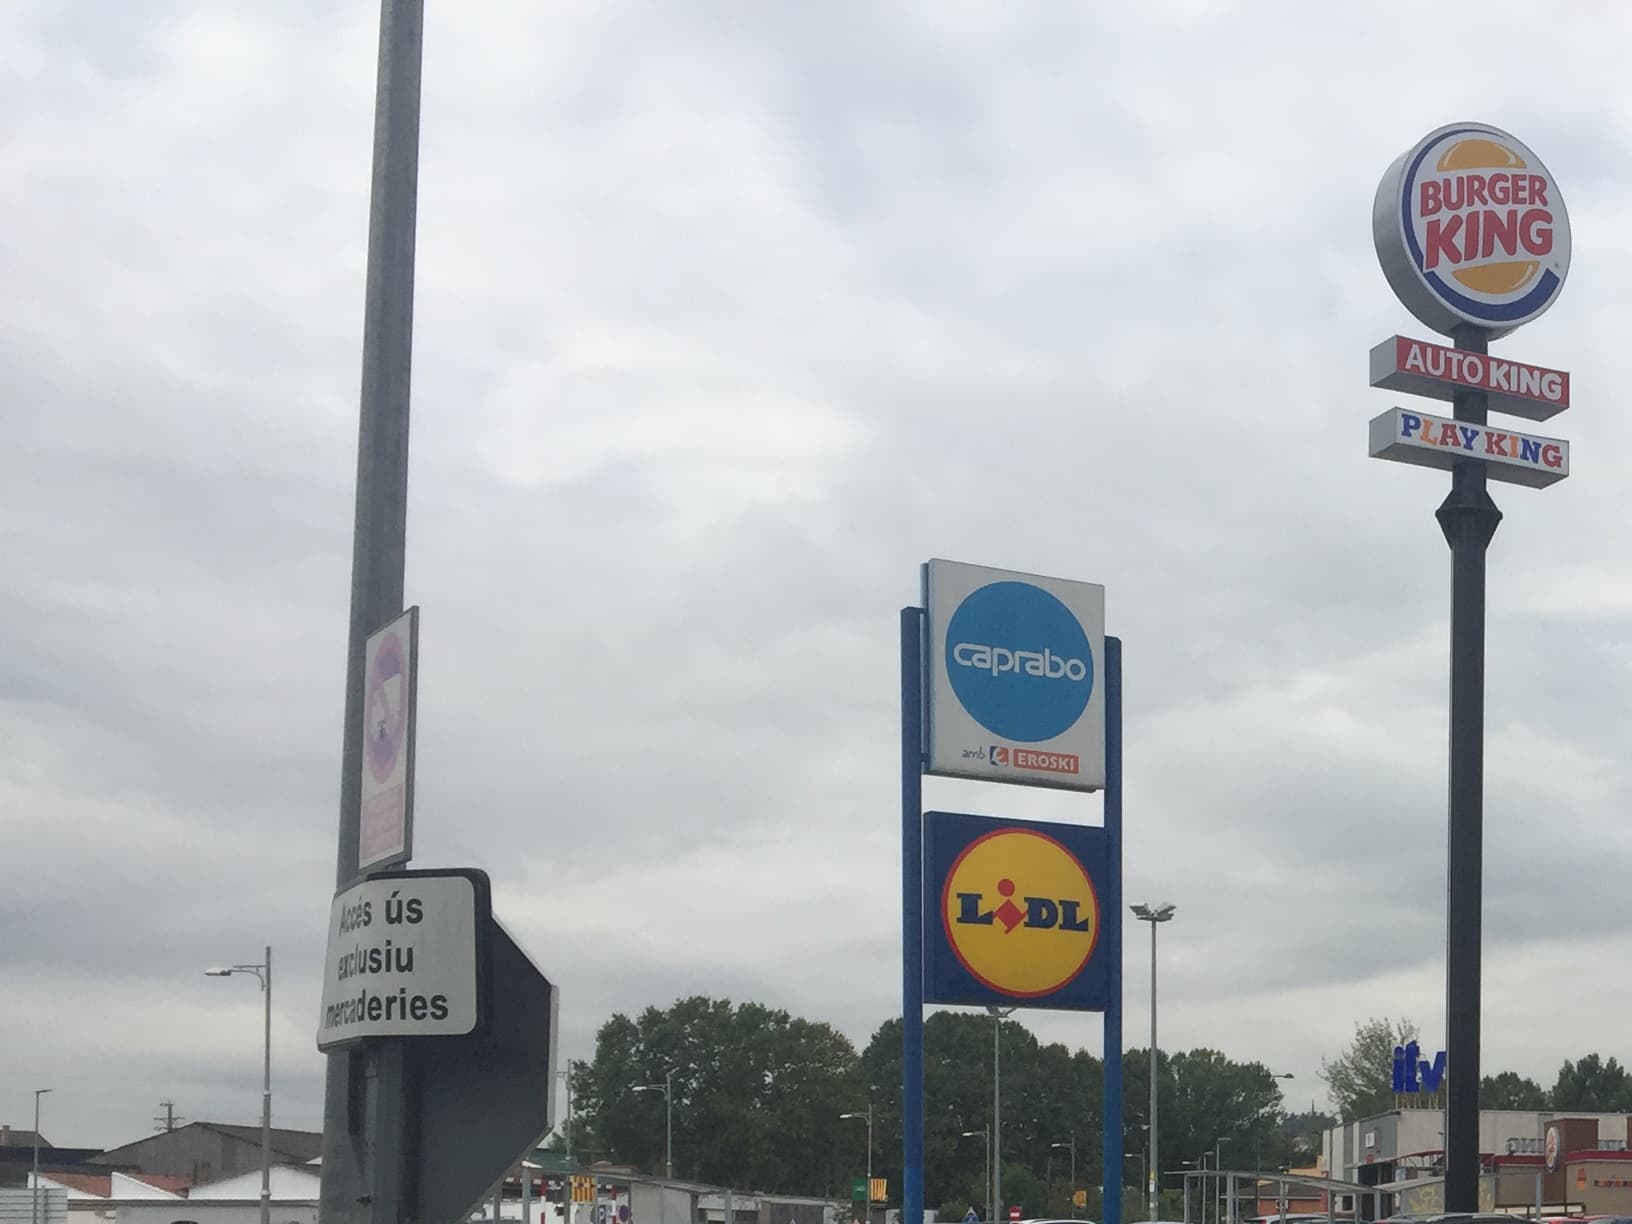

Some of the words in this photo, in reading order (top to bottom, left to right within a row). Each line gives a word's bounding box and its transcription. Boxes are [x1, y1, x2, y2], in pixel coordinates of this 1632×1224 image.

[1419, 173, 1548, 217] BURGER
[1424, 209, 1554, 270] KING
[1405, 344, 1483, 384] AUTO
[1489, 360, 1563, 401] KING
[1401, 413, 1481, 451] PLAY
[1485, 431, 1563, 469] KING
[952, 643, 1087, 682] caprabo
[961, 746, 986, 761] amb
[1017, 752, 1075, 770] EROSKI
[338, 896, 373, 936] Accés
[385, 890, 424, 925] ús
[337, 940, 414, 981] exclusiu
[325, 987, 449, 1030] mercaderies
